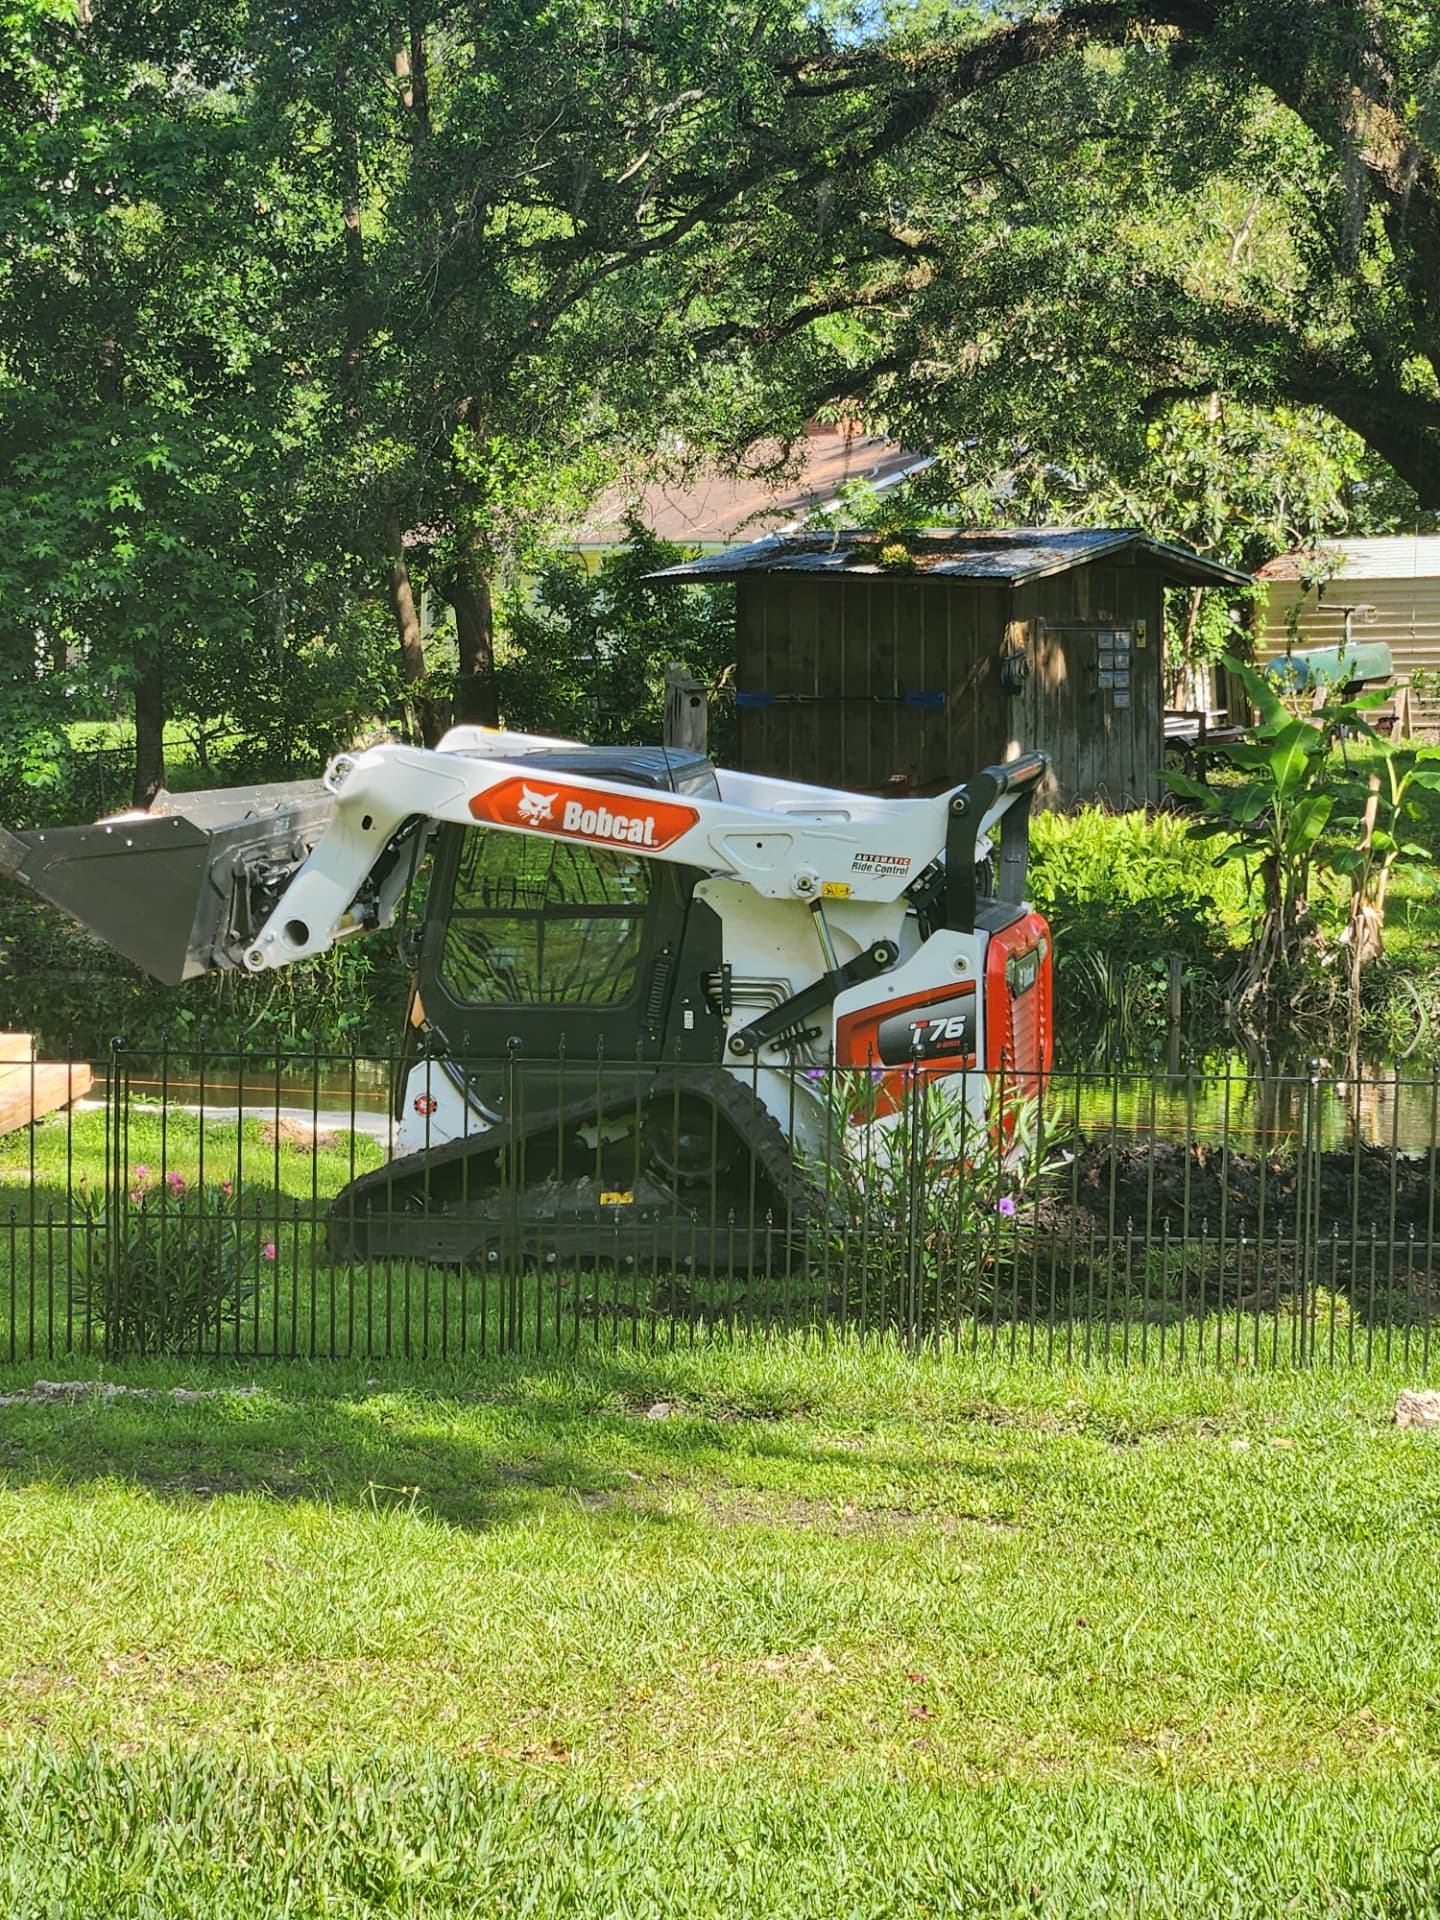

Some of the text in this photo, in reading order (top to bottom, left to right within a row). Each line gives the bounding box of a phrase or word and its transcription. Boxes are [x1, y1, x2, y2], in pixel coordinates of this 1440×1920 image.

[563, 801, 656, 845] Bobcat
[851, 861, 909, 875] Ride Control
[856, 854, 911, 865] AUTOMATIC
[909, 1015, 967, 1045] T76
